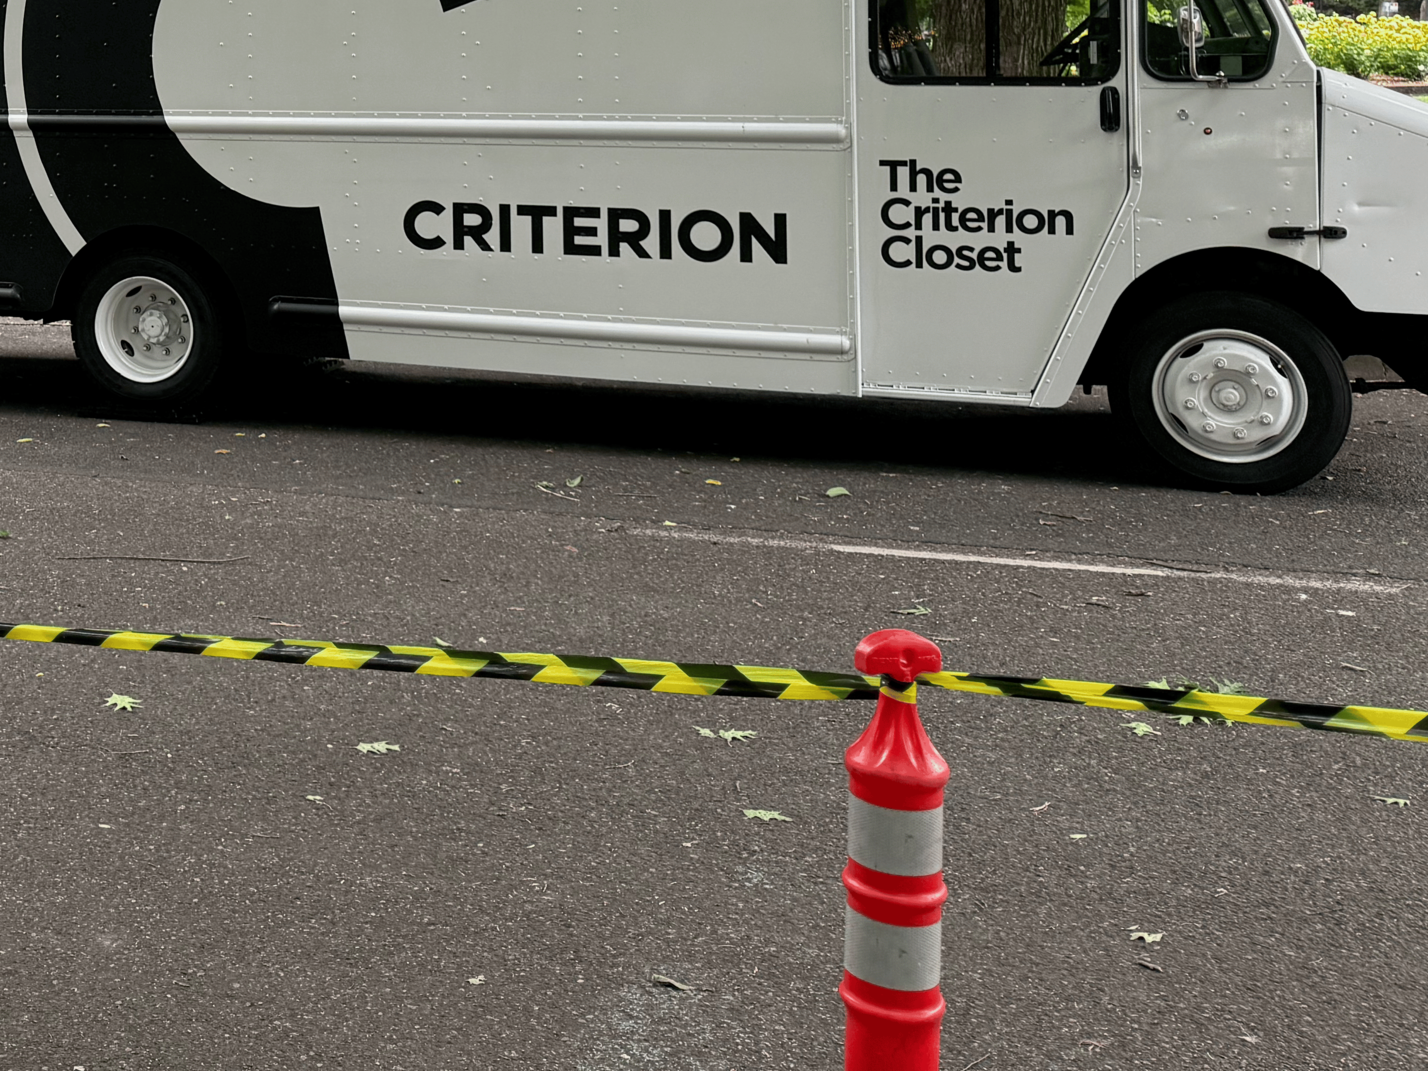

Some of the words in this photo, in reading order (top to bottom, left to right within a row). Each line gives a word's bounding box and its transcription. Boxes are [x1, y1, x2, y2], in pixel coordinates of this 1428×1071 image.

[879, 159, 963, 194] The
[403, 200, 789, 265] CRITERION
[881, 197, 1074, 236] Criterion
[881, 235, 1022, 273] Closet
